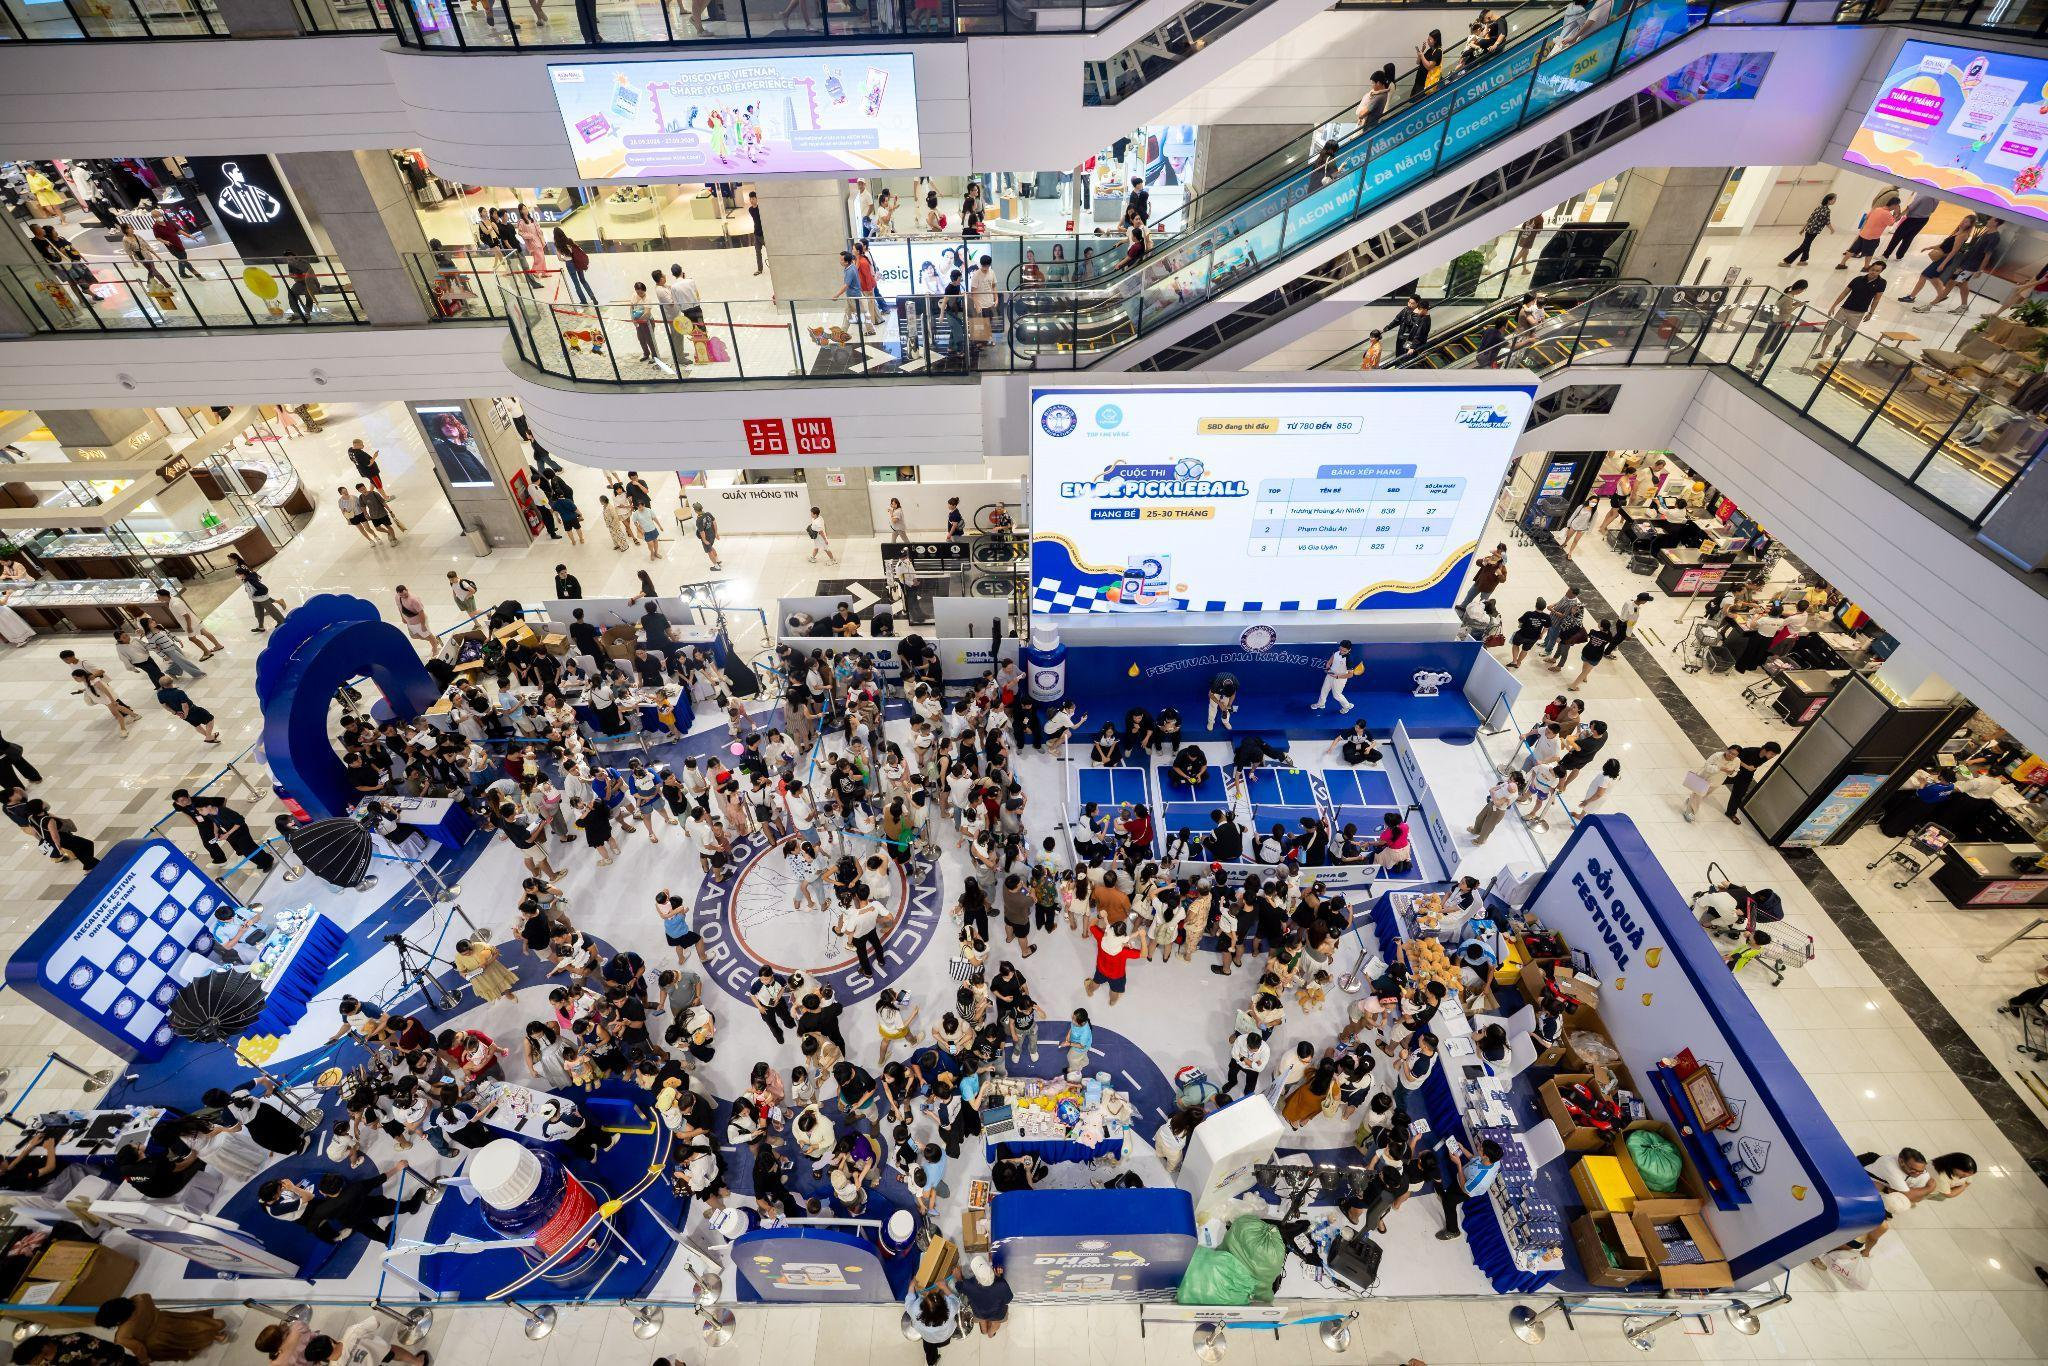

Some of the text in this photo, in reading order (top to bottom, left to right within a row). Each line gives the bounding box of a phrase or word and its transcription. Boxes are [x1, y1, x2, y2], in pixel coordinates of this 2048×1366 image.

[1573, 52, 1598, 74] 30K
[680, 71, 731, 83] DISCOVER
[670, 78, 796, 96] SHARE YOUR EXPERIENCE
[1299, 201, 1335, 228] AEON
[1455, 108, 1499, 139] Green
[1500, 94, 1523, 115] SM
[797, 422, 827, 436] UNI
[1207, 422, 1270, 432] SBD đang thi đấu
[1287, 420, 1353, 430] TỪ 780 ĐẾN 850
[800, 437, 831, 451] QLO
[1120, 468, 1166, 479] CUỘC THI
[750, 489, 782, 499] THÔNG
[784, 490, 799, 499] TIN
[1124, 480, 1249, 498] PICKLEBALL
[1094, 508, 1208, 520] HẠNG BÉ 25-30 THÁNG
[1146, 653, 1219, 679] FESTIVAL
[1221, 652, 1253, 663] DHA
[1254, 649, 1308, 666] KHÔNG
[73, 871, 137, 942] MEGALIVE FESTIVAL
[88, 884, 137, 938] DHA KHÔNG TANH
[1587, 857, 1645, 950] ĐỔI QUÀ
[1571, 871, 1629, 972] FESTIVAL
[1033, 1256, 1101, 1265] DHA
